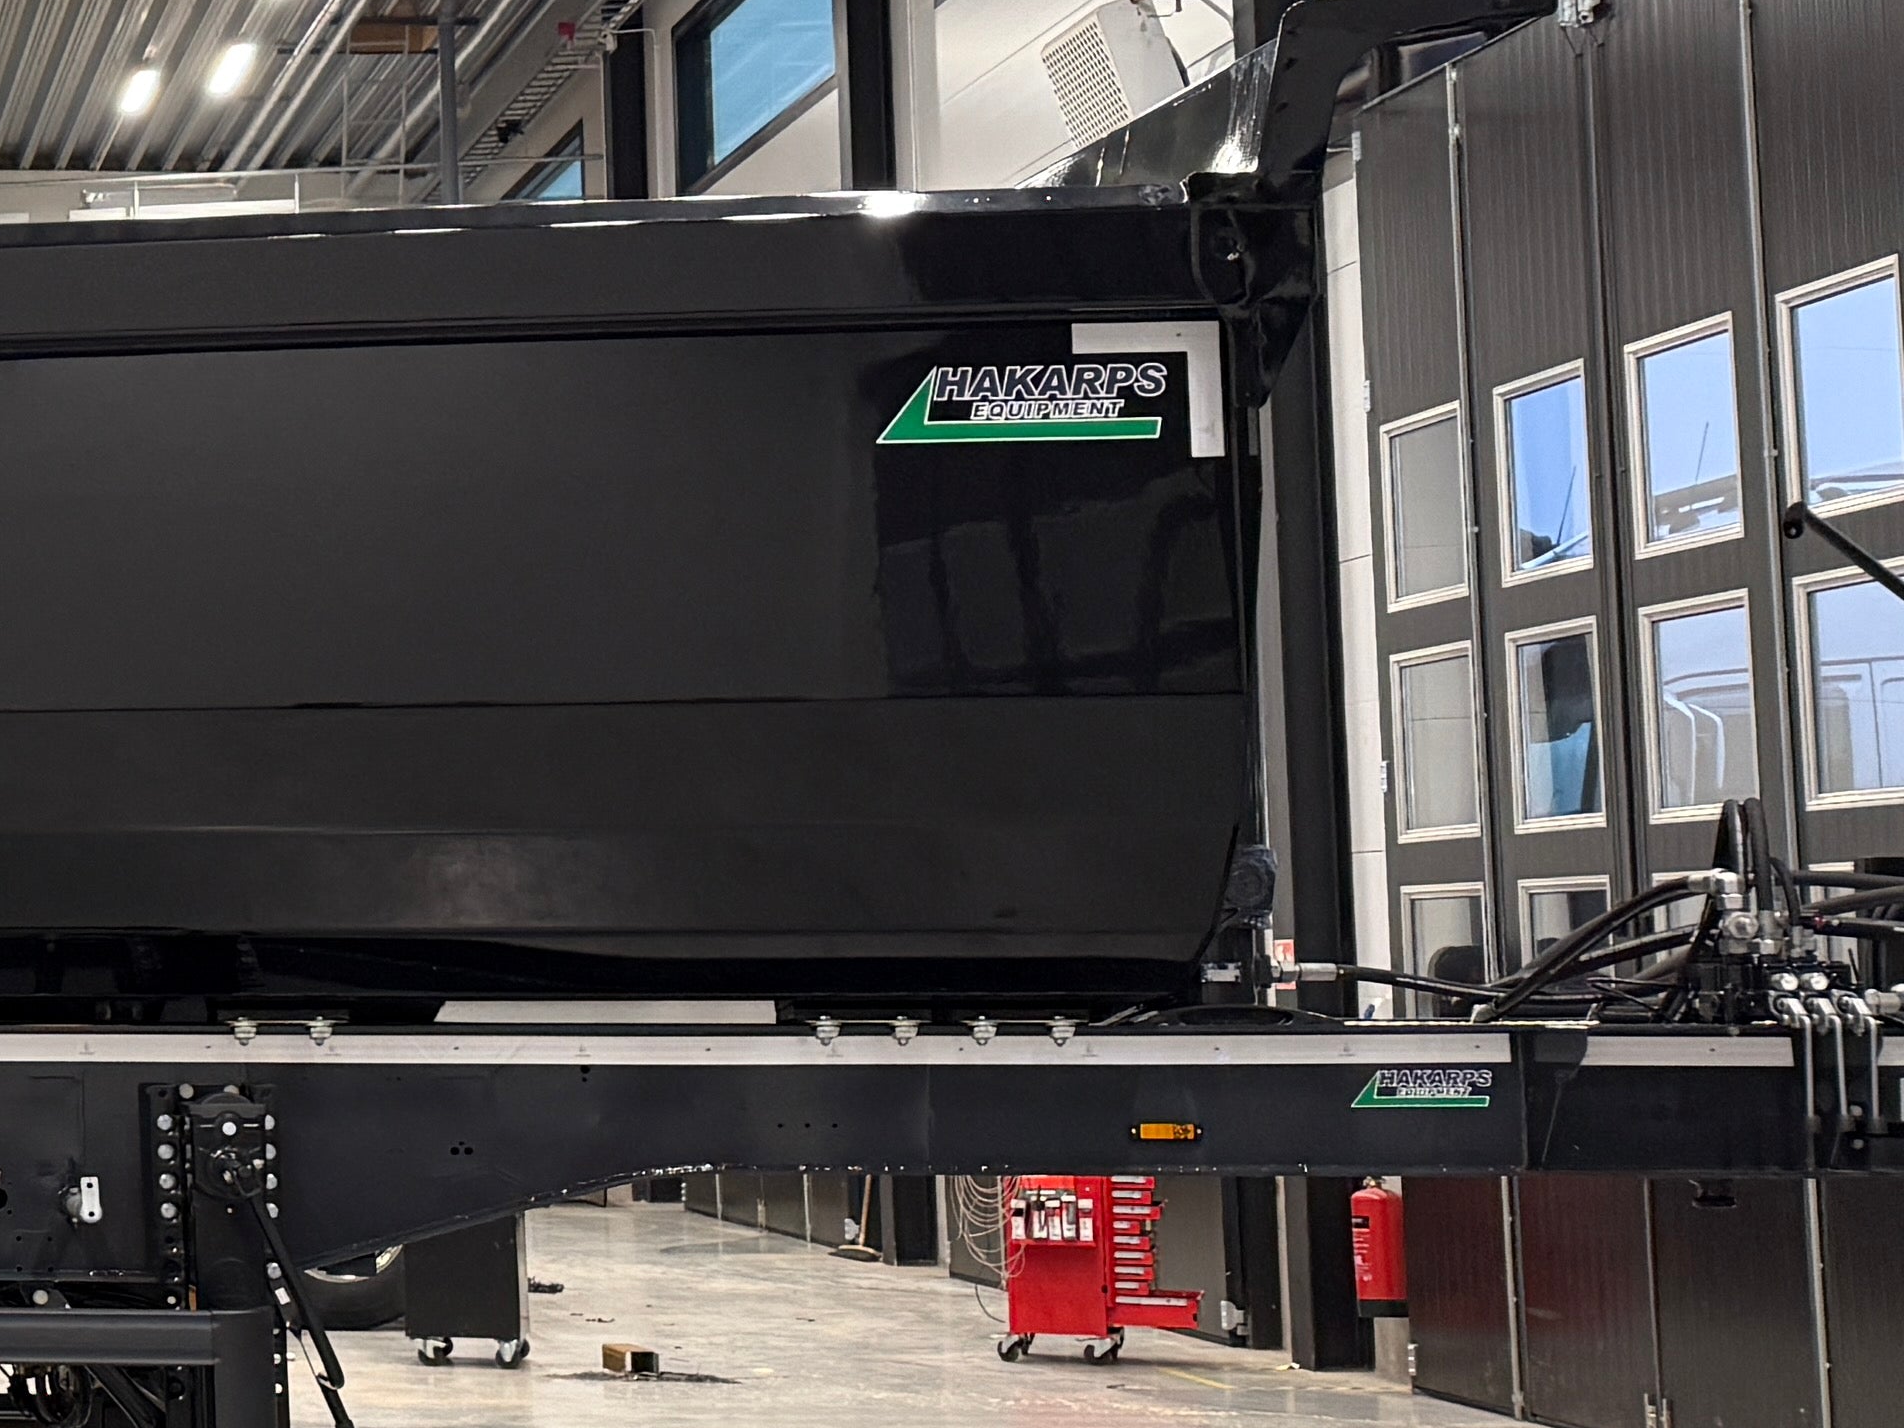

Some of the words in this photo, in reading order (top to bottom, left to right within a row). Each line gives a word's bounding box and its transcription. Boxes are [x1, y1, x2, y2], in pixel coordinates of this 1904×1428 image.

[934, 363, 1167, 401] HAKARPS
[970, 399, 1124, 420] EQUIPMENT
[1378, 1069, 1492, 1087] HAKARPS
